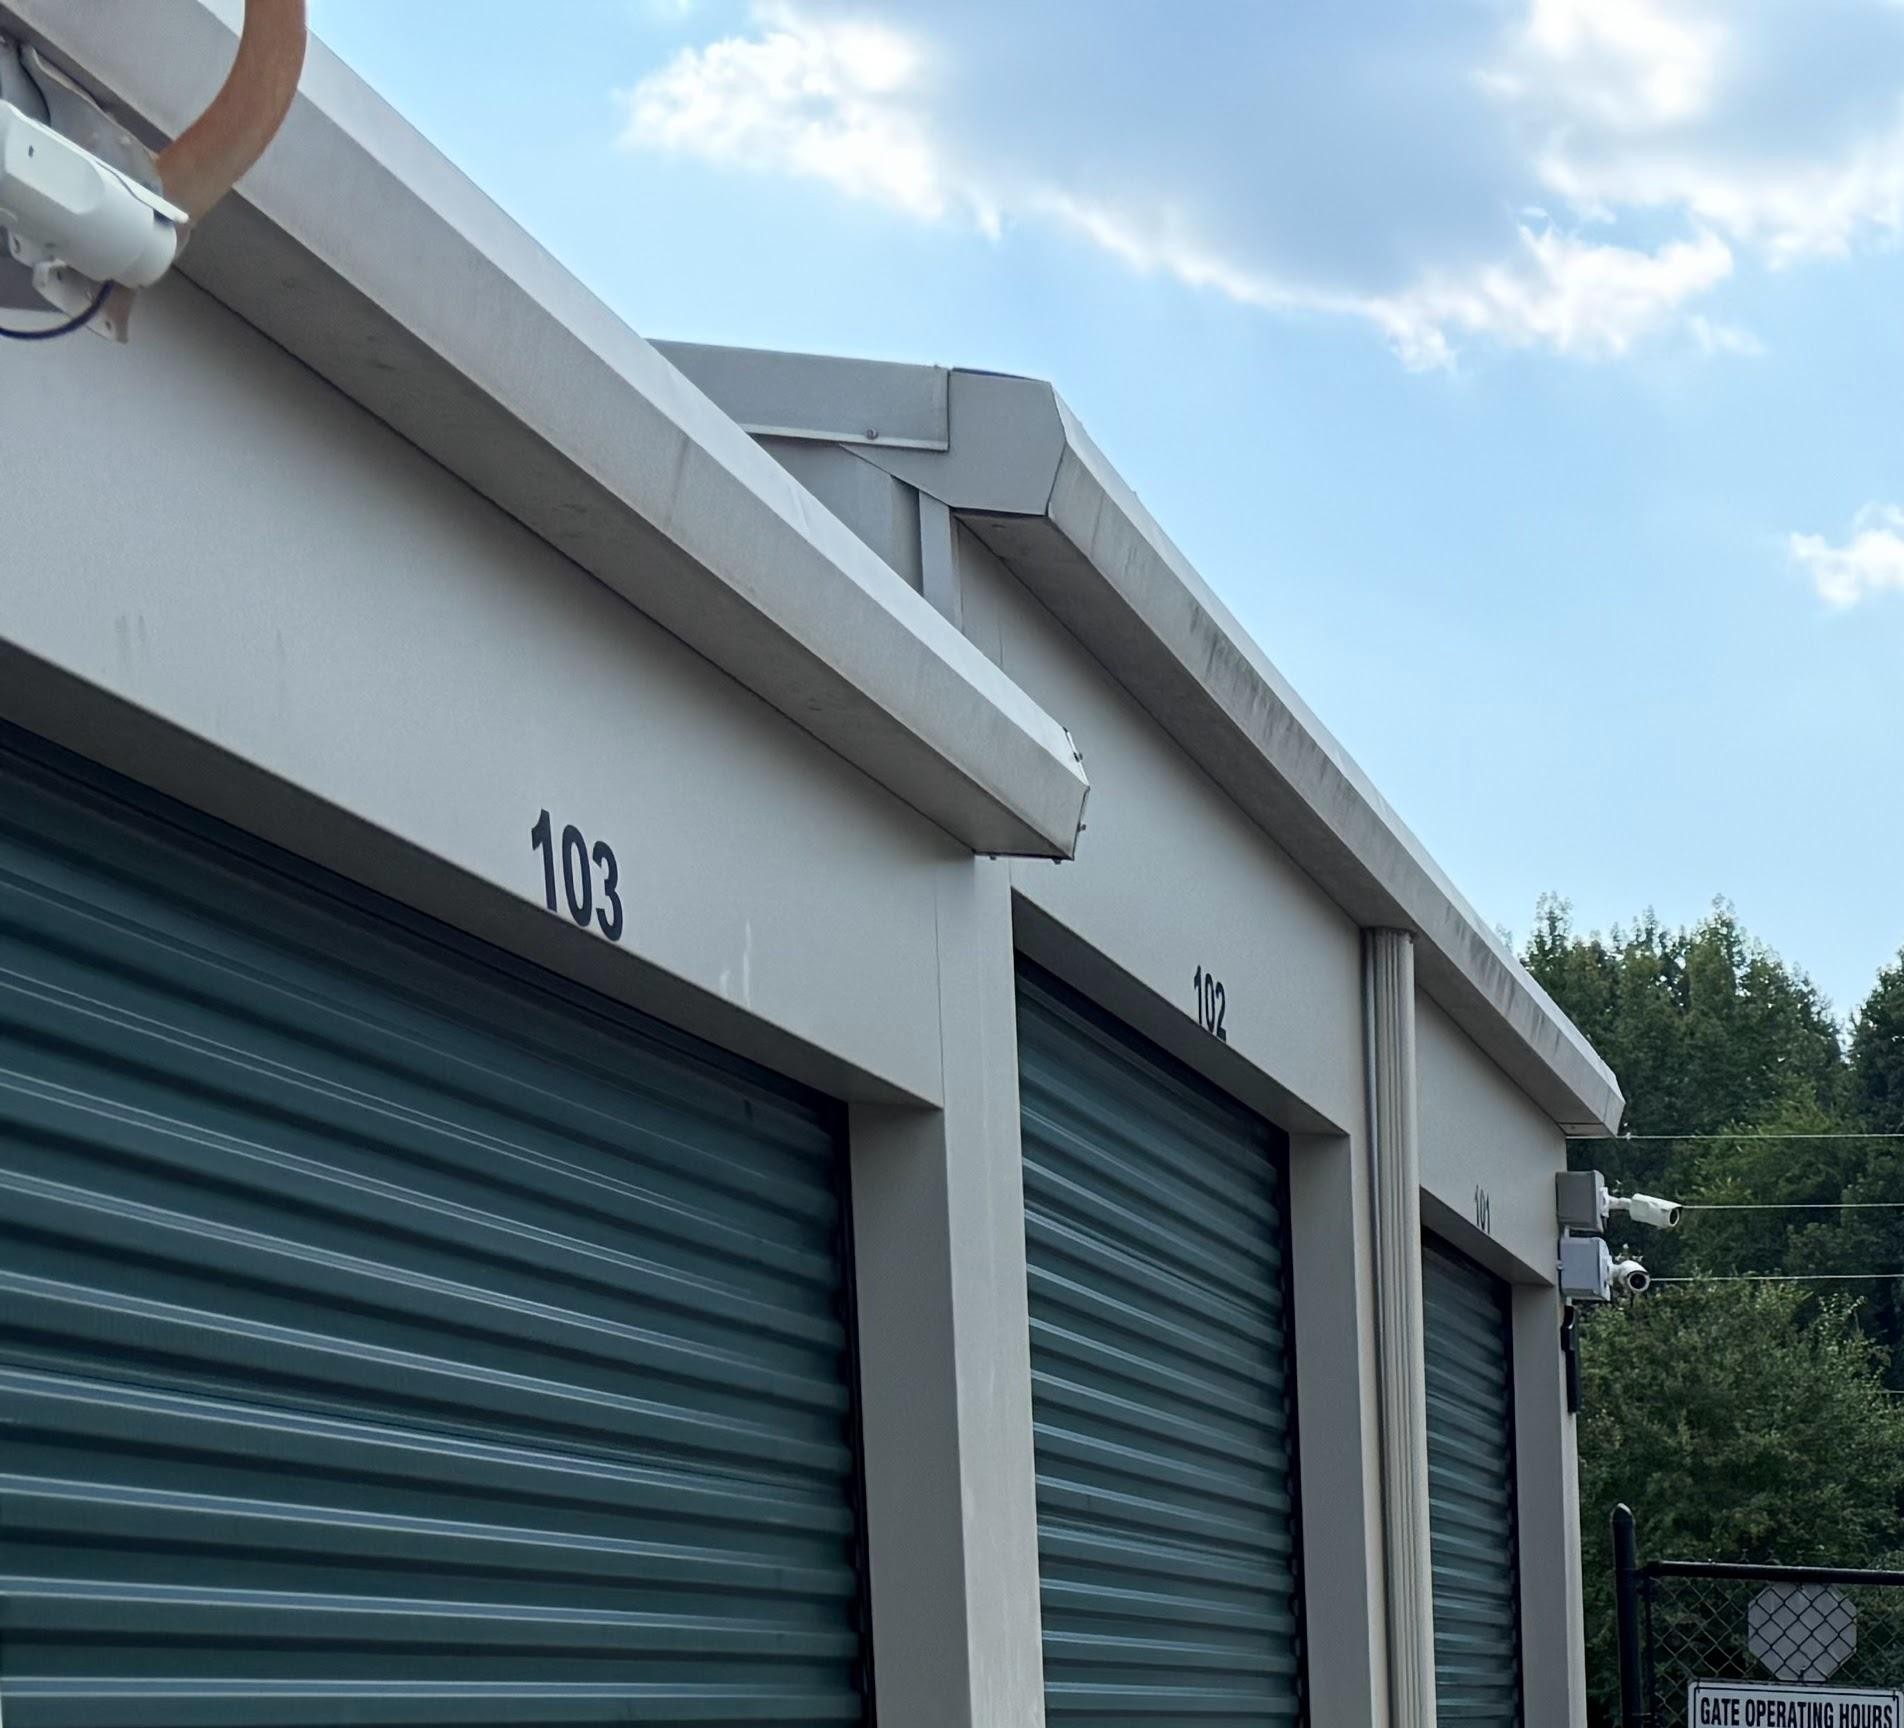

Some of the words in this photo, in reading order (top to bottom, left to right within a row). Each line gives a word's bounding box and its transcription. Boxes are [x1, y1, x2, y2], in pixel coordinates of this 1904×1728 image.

[531, 808, 623, 942] 103
[1193, 964, 1227, 1043] 102
[1474, 1184, 1491, 1235] 101
[1700, 1697, 1740, 1726] GATE
